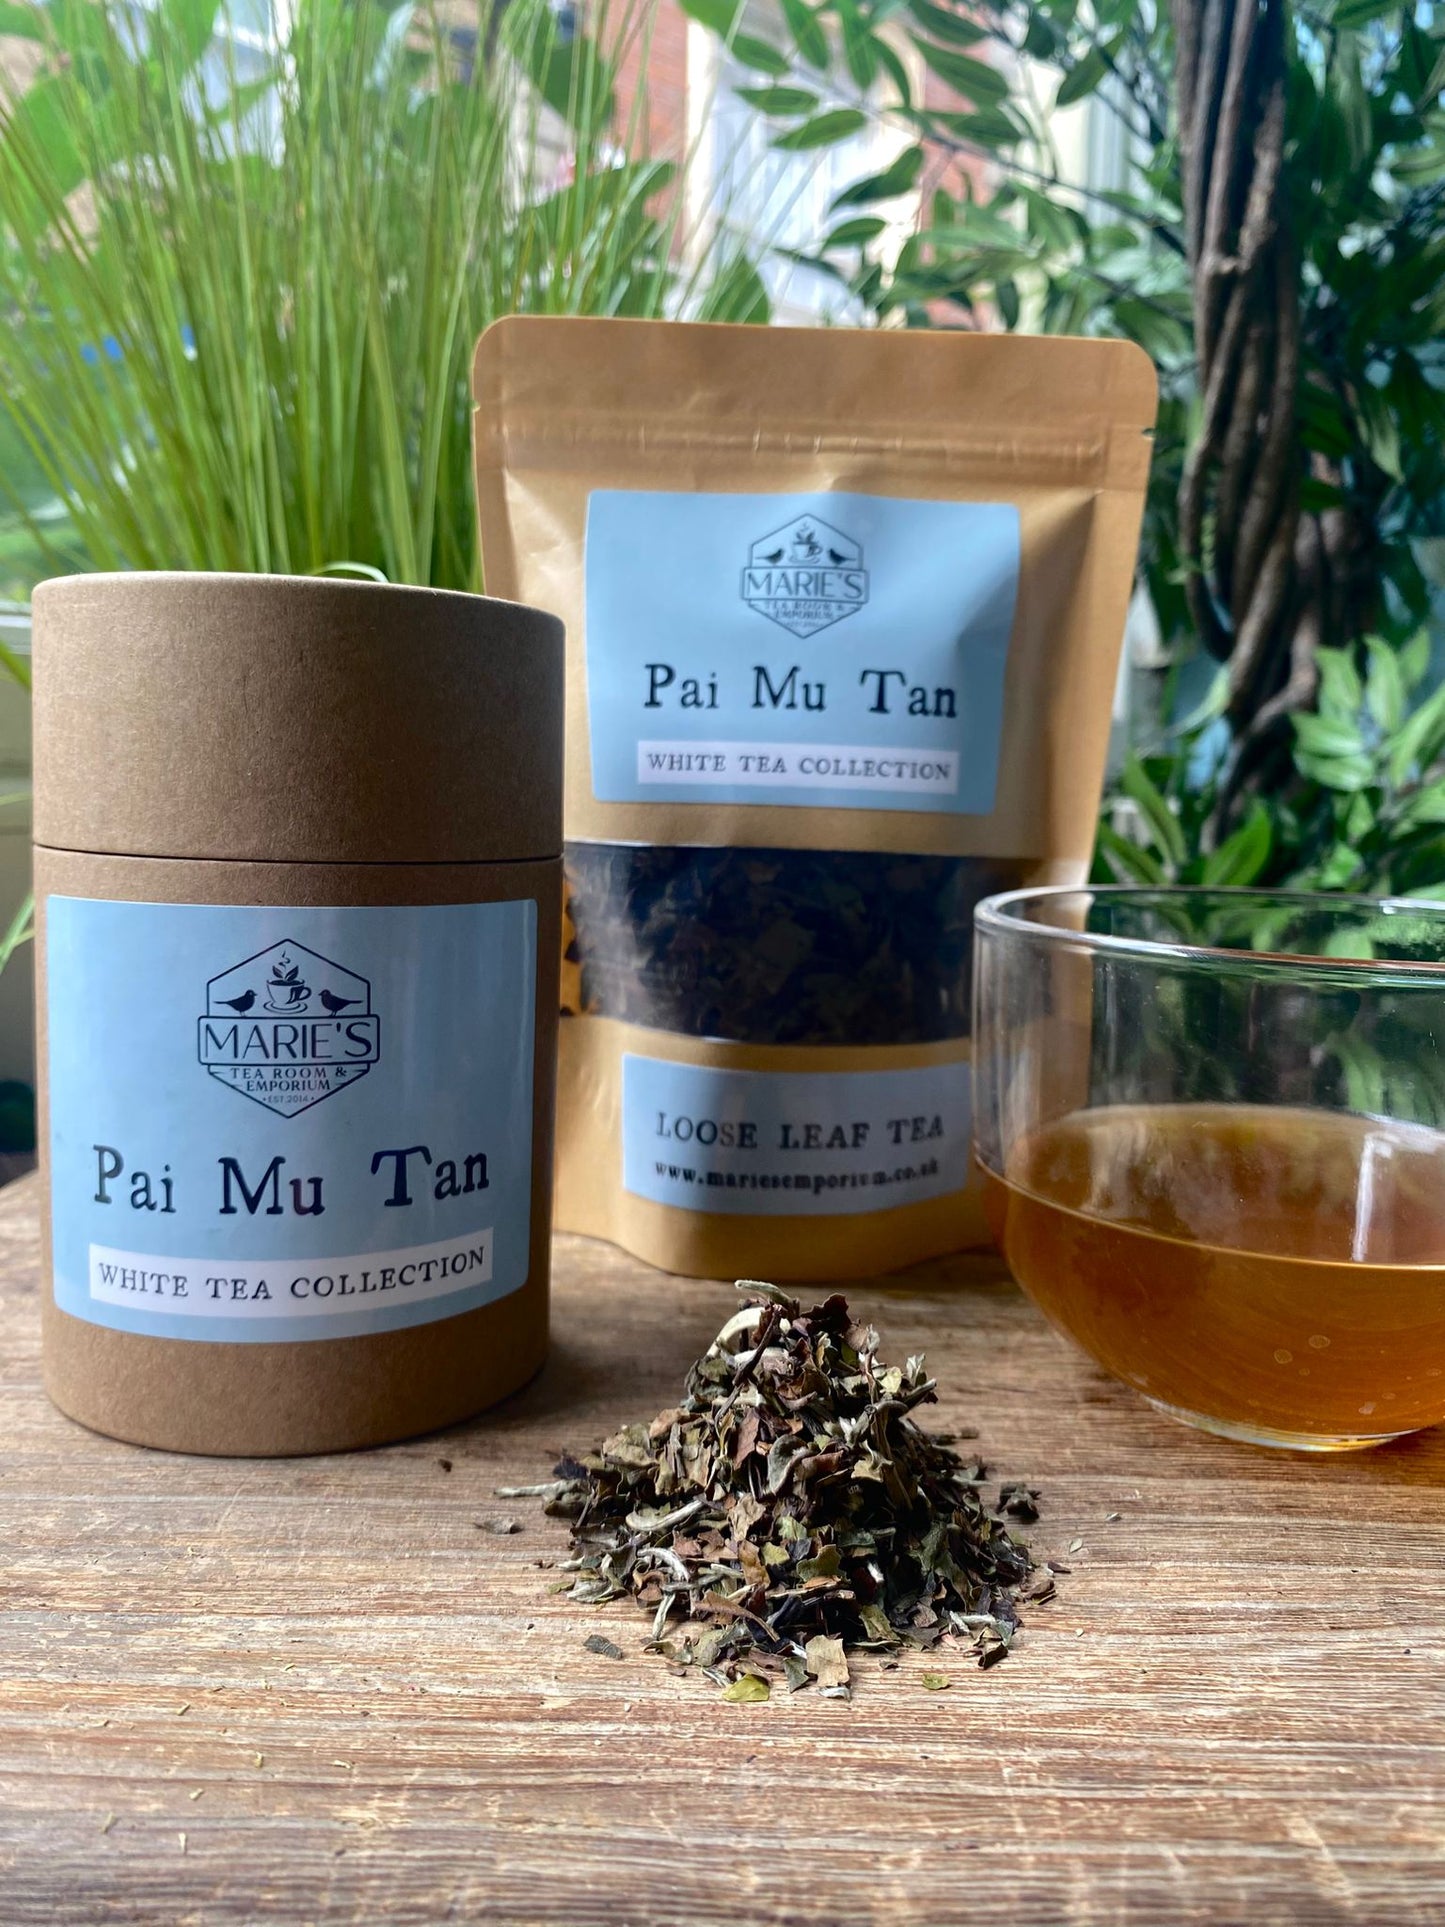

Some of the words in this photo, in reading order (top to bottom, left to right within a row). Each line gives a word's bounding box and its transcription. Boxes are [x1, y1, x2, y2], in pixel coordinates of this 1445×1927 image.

[747, 571, 863, 599] MARIE'S
[644, 663, 720, 709] Pai
[752, 665, 826, 711] Mu
[859, 669, 957, 719] Tan
[648, 753, 726, 773] WHITE
[739, 754, 788, 774] TEA
[799, 757, 950, 781] COLLECTION
[205, 1021, 372, 1059] MARIE'S
[230, 1067, 265, 1079] TEA
[273, 1066, 328, 1079] ROOM
[335, 1065, 348, 1077] &
[246, 1079, 331, 1092] EMPORIUM
[656, 1111, 758, 1149] LOOSE
[780, 1122, 870, 1150] LEAF
[887, 1114, 945, 1145] TEA
[93, 1144, 176, 1214] Pai
[218, 1155, 326, 1216] Mu
[371, 1145, 490, 1208] Tan
[98, 1262, 189, 1298] WHITE
[205, 1278, 273, 1300] TEA
[290, 1246, 485, 1299] COLLECTION
